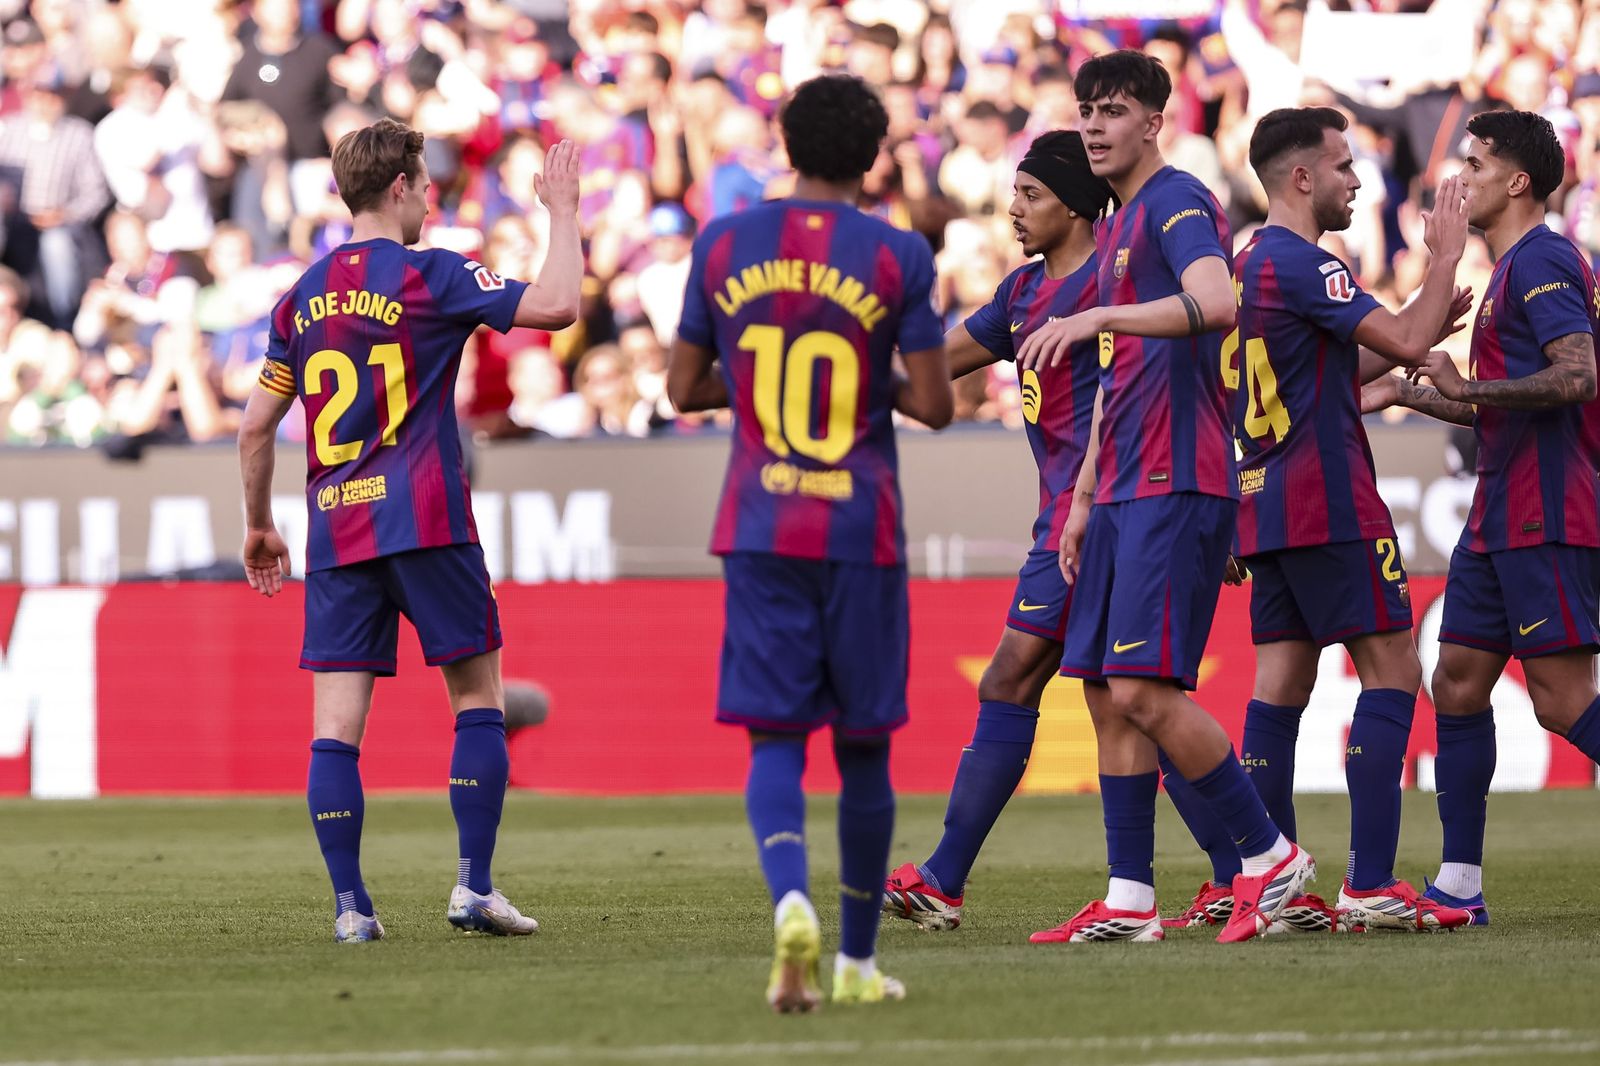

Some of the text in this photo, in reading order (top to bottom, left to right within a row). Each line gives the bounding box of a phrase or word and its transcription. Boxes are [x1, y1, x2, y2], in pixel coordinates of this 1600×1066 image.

[1162, 208, 1200, 233] AMBILIGHT
[713, 259, 888, 332] LAMINE YAMAL
[1523, 282, 1561, 303] AMBILIGHT
[294, 290, 403, 335] F. DE JONG
[303, 343, 408, 467] 21
[737, 324, 860, 464] 10
[340, 475, 386, 492] UNHCR
[342, 484, 387, 502] ACNUR
[1375, 537, 1407, 581] 2
[1240, 758, 1269, 768] ARÇA
